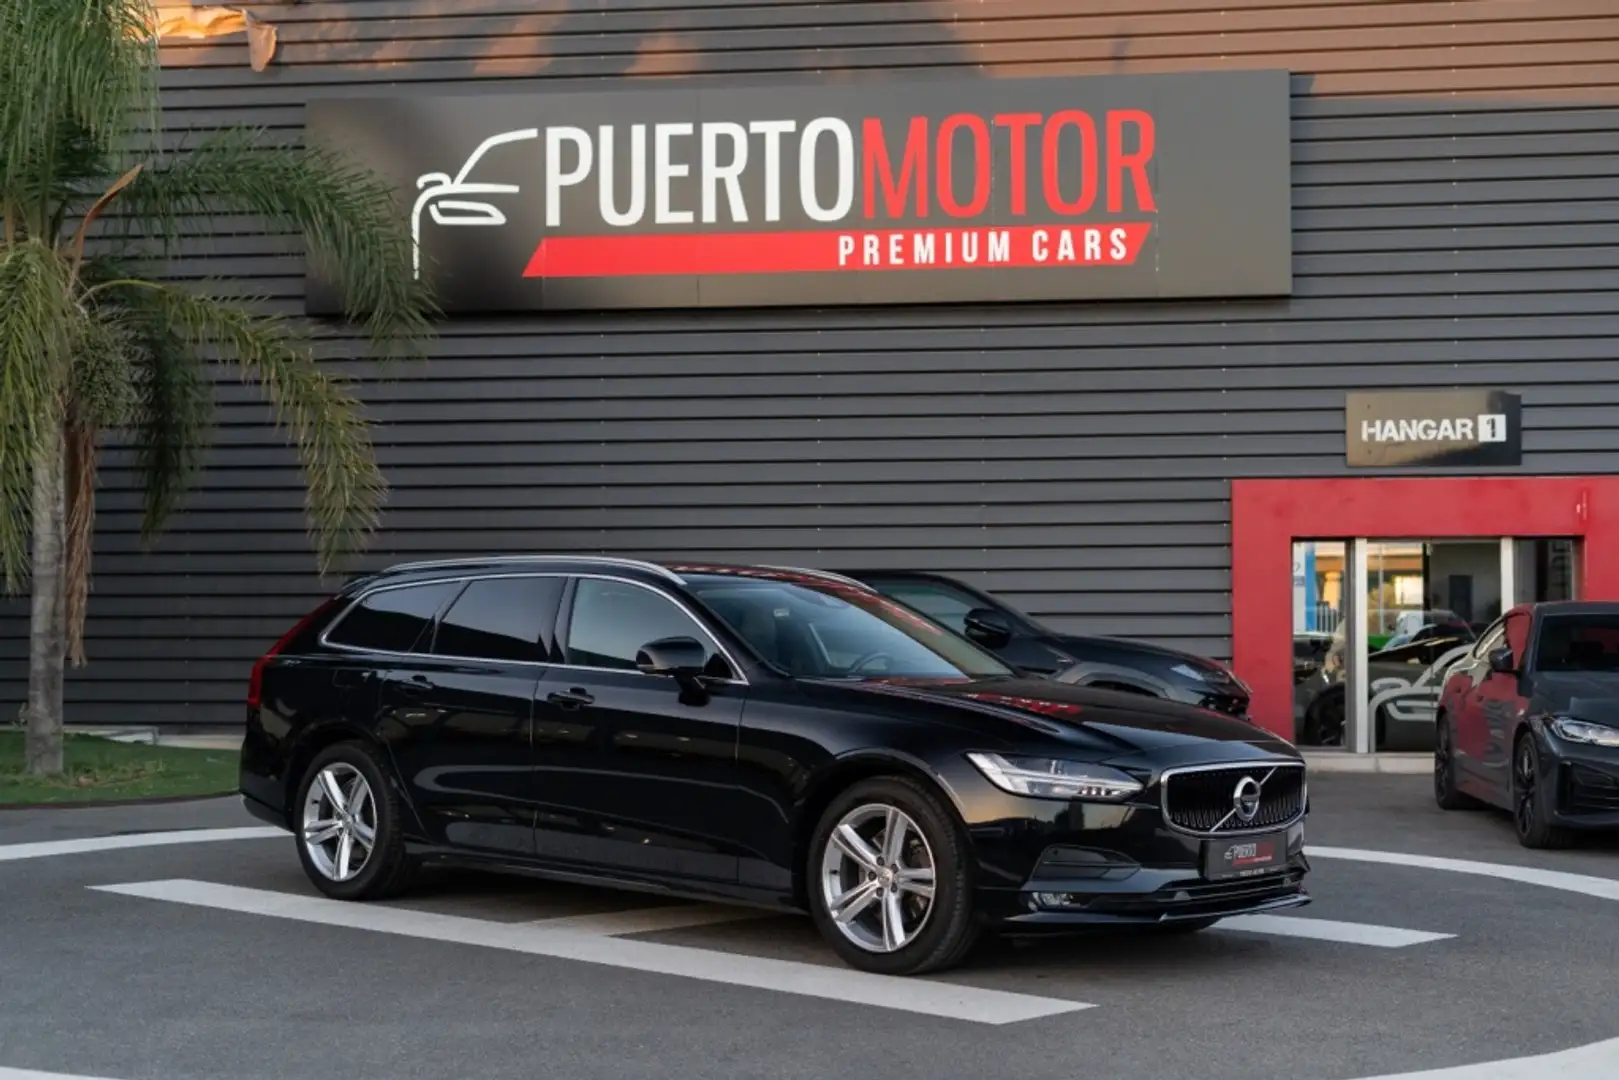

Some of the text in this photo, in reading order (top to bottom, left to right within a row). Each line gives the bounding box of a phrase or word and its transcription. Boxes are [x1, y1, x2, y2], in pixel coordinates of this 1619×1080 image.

[838, 228, 1127, 266] PREMIUM CARS
[1361, 418, 1474, 442] HANGAR
